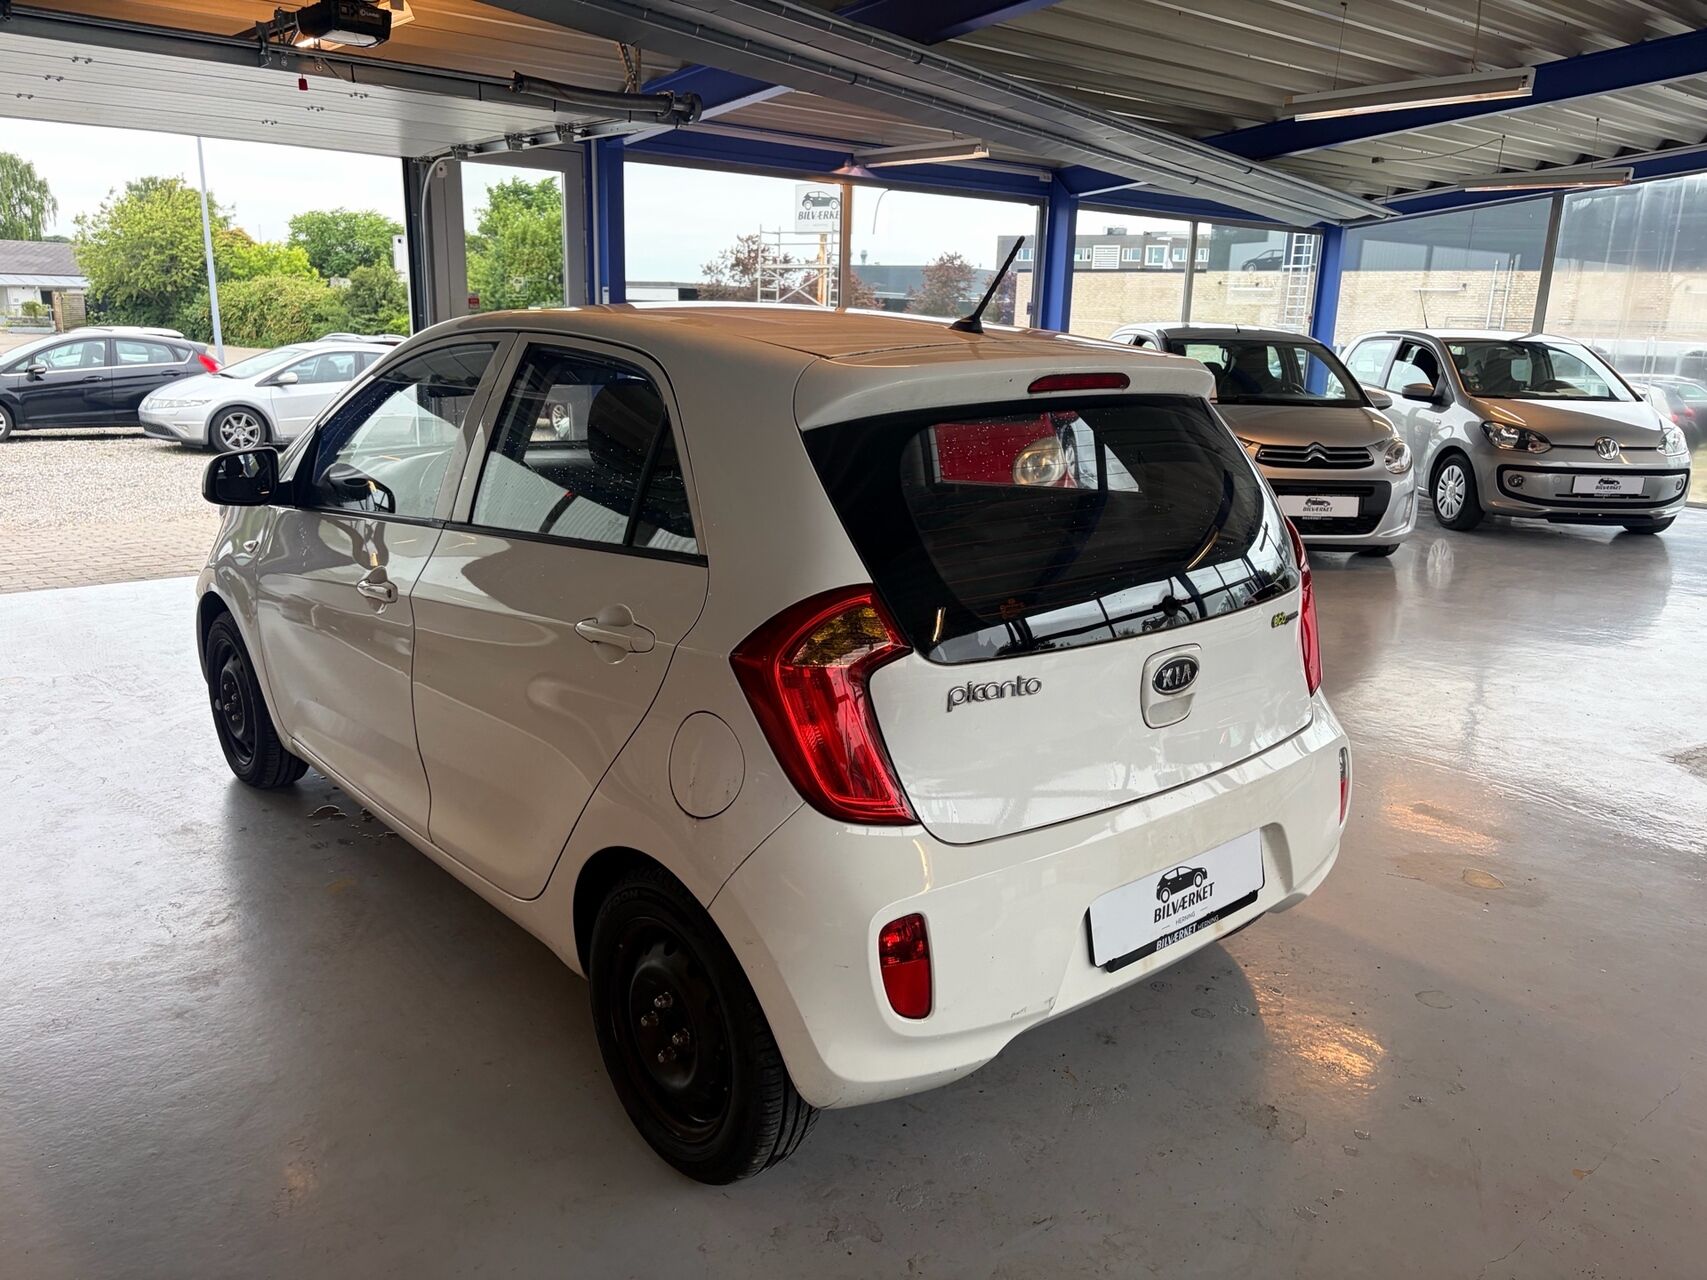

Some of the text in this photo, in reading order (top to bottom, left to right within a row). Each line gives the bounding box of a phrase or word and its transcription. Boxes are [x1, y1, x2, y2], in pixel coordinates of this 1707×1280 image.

[1161, 662, 1193, 689] KIA
[946, 675, 1043, 713] picanto
[1153, 881, 1215, 924] BILVÆRKET
[1156, 922, 1198, 951] BILVÆRKET
